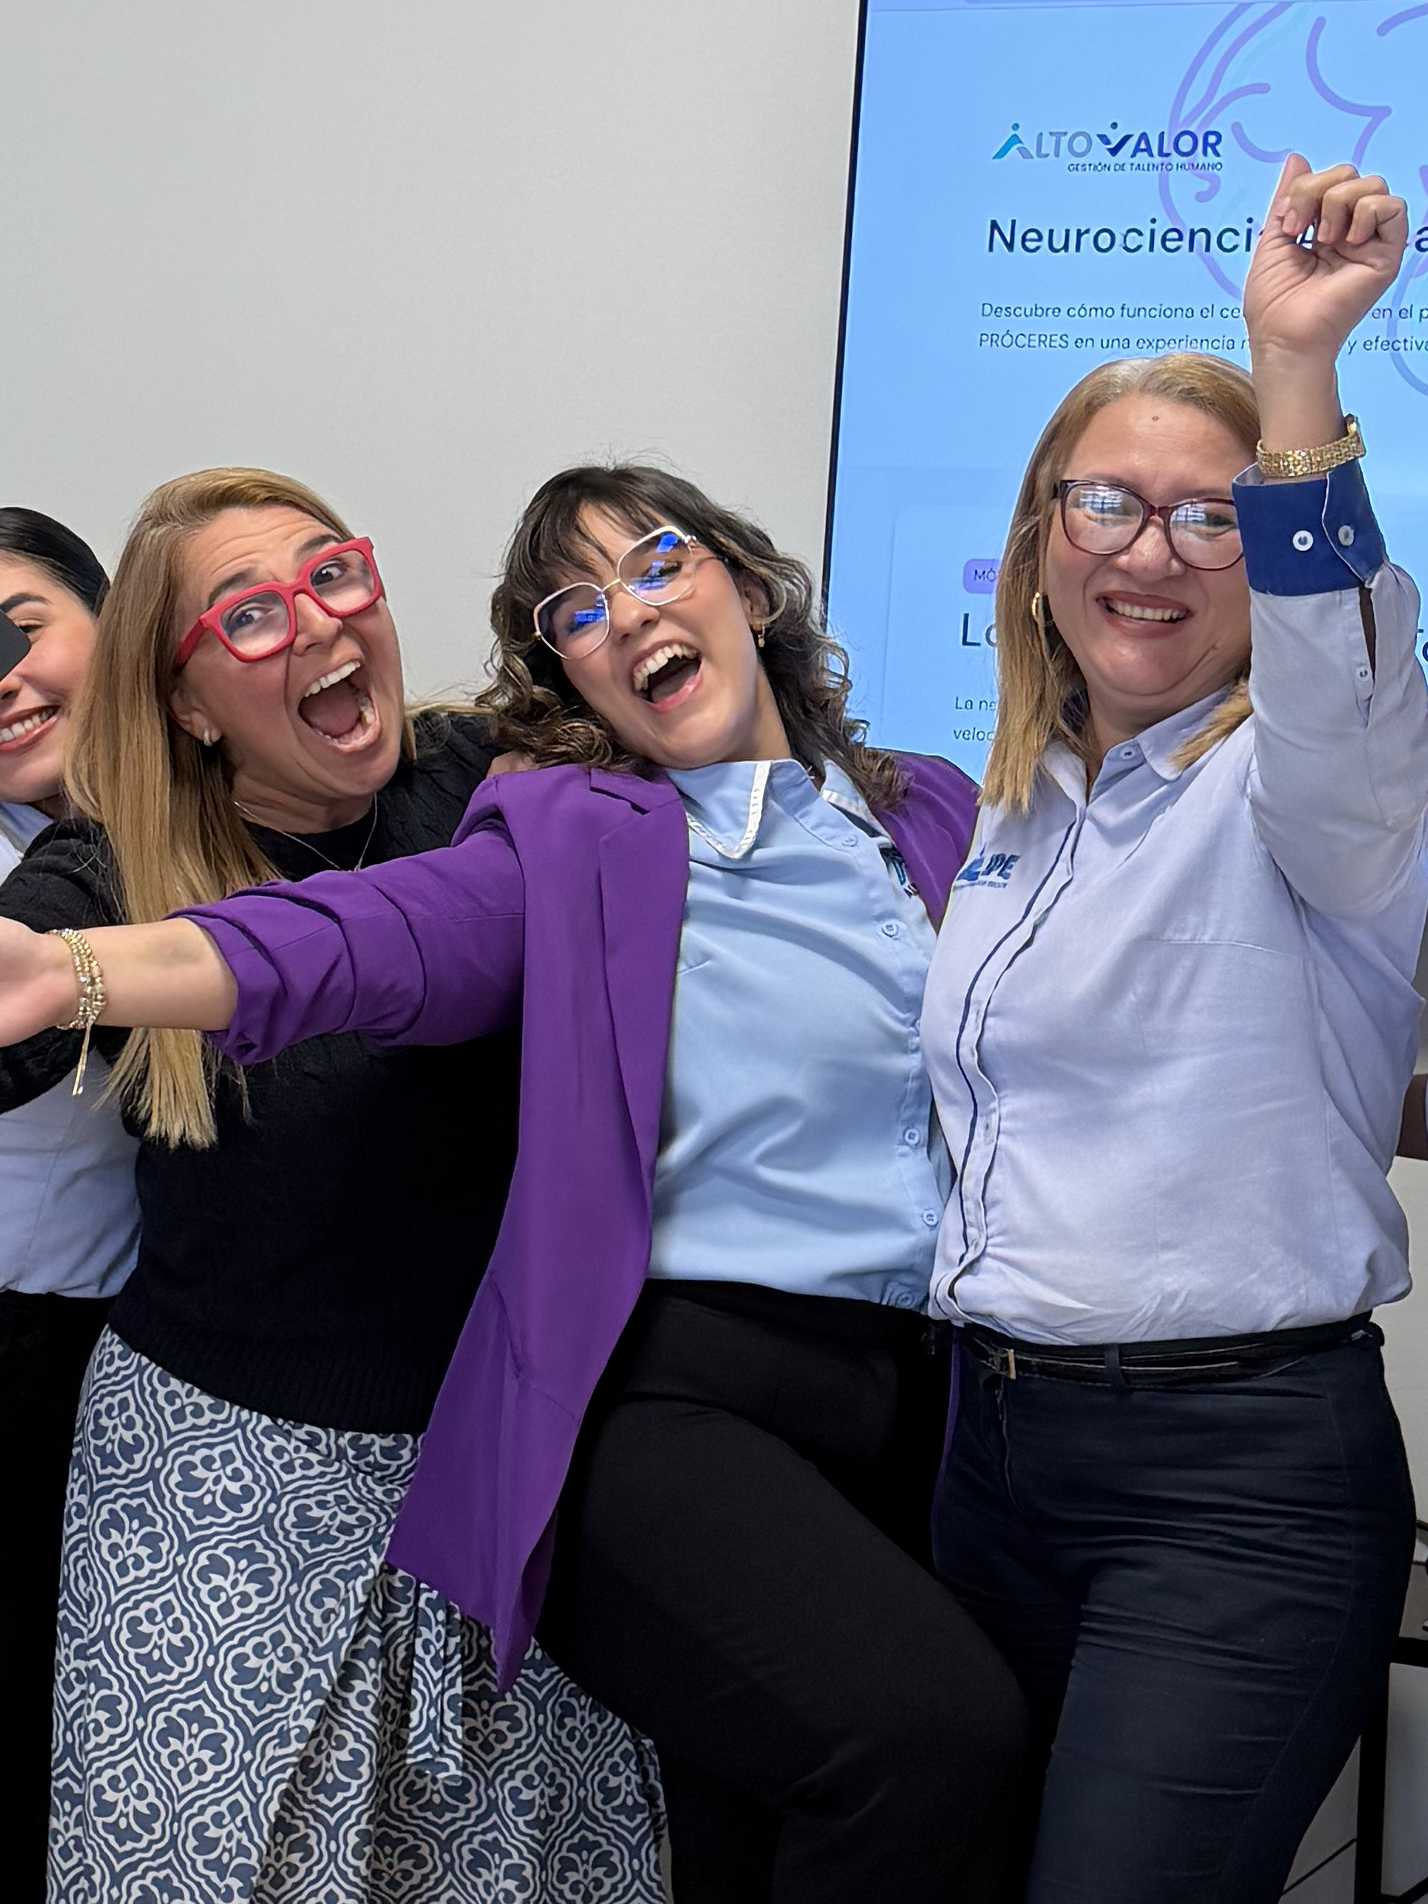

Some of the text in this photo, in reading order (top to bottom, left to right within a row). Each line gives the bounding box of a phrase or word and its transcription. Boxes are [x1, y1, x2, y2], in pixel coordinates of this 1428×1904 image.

[1113, 162, 1127, 173] DE
[1129, 161, 1173, 173] TALENTO
[987, 217, 1263, 254] Neurocienci
[980, 302, 1062, 321] Descubre
[1066, 301, 1116, 321] cómo
[1119, 302, 1195, 321] funciona
[1200, 302, 1216, 320] el
[1398, 302, 1414, 320] el
[979, 328, 1069, 349] PRÓCERES
[1073, 338, 1096, 350] en
[1100, 338, 1131, 351] una
[1135, 334, 1236, 354] experiencia
